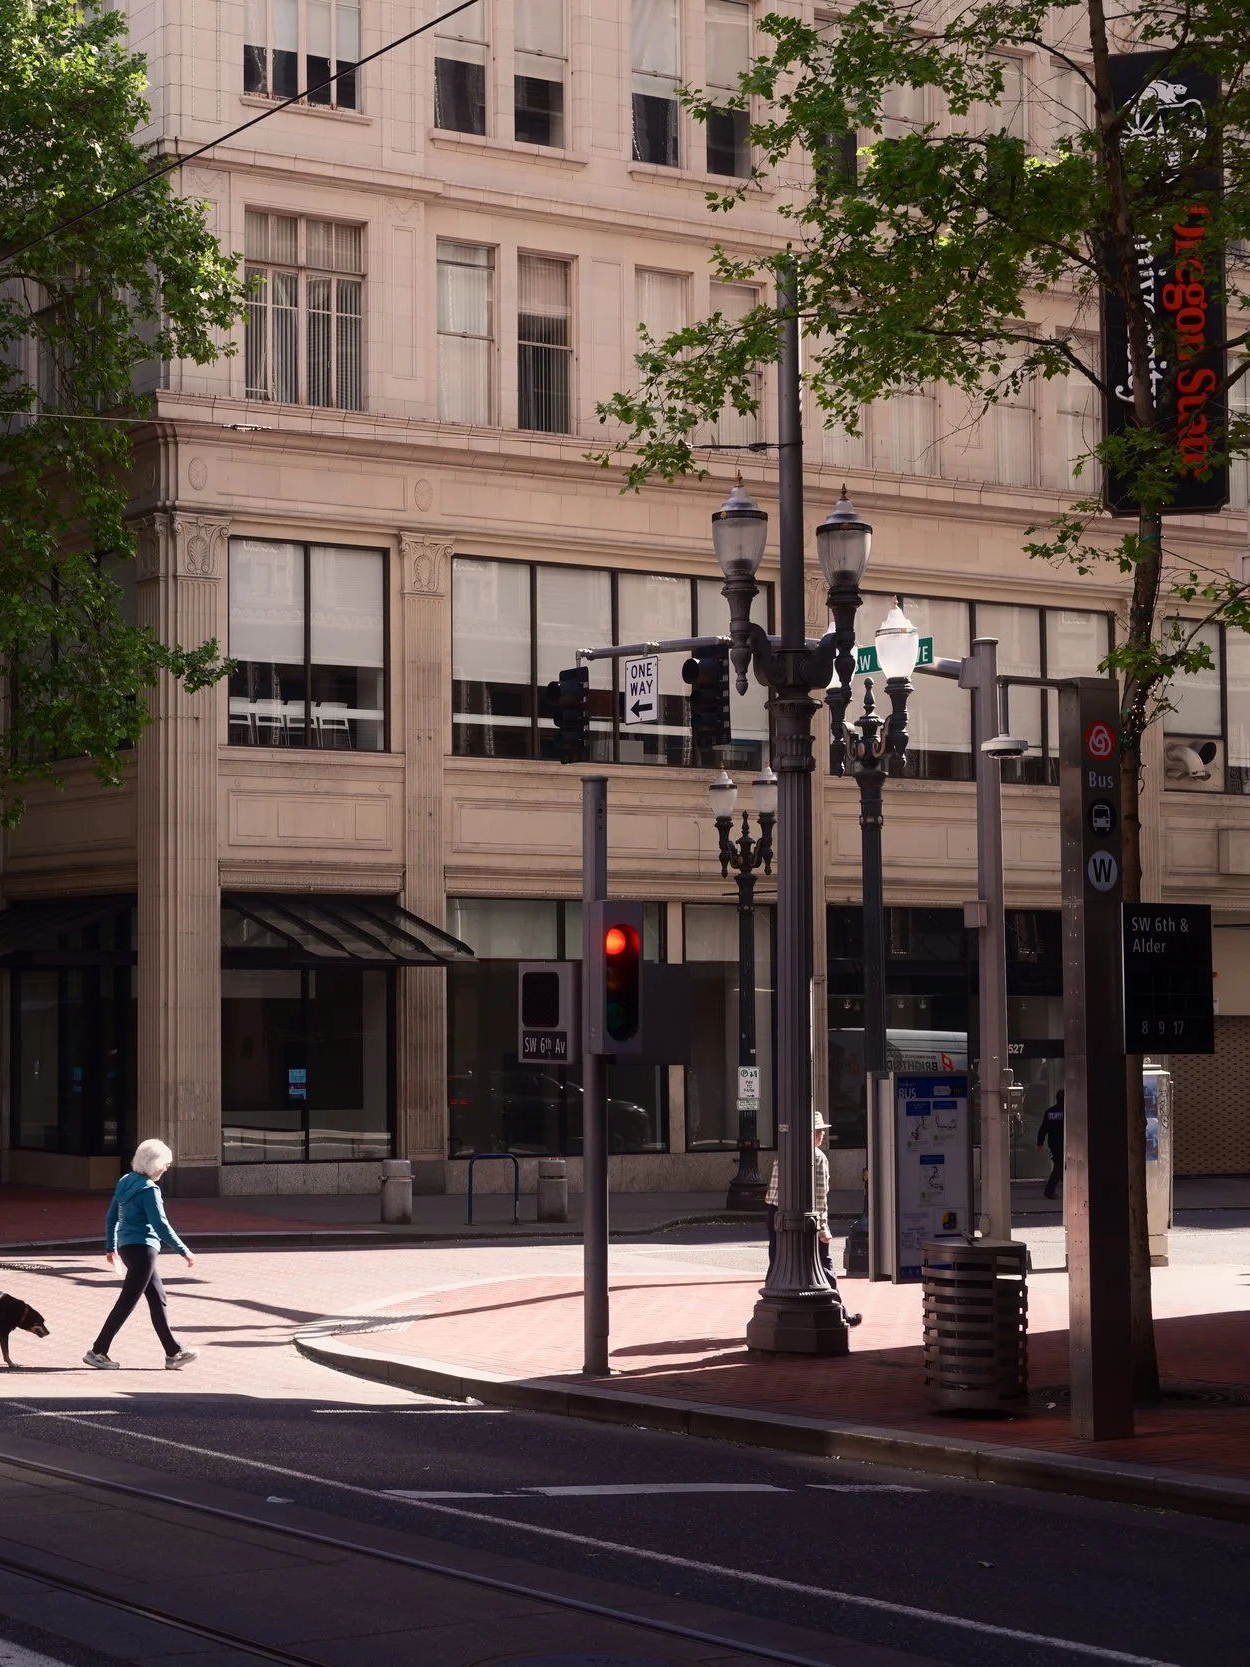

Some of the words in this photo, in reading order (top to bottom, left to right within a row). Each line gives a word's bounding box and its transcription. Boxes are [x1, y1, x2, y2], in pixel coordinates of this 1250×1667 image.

[631, 662, 653, 679] ONE
[630, 680, 653, 697] WAY
[1088, 771, 1114, 789] Bus
[1092, 858, 1113, 883] W
[1131, 917, 1152, 933] SW
[1155, 917, 1176, 933] 6th
[1180, 917, 1189, 933] &
[1132, 938, 1167, 954] Alder
[1141, 1020, 1149, 1035] 8
[1158, 1020, 1165, 1035] 9
[1173, 1020, 1185, 1035] 17
[524, 1037, 537, 1053] SW
[540, 1037, 552, 1053] 6th
[555, 1038, 566, 1054] Av
[1008, 1044, 1024, 1054] 527
